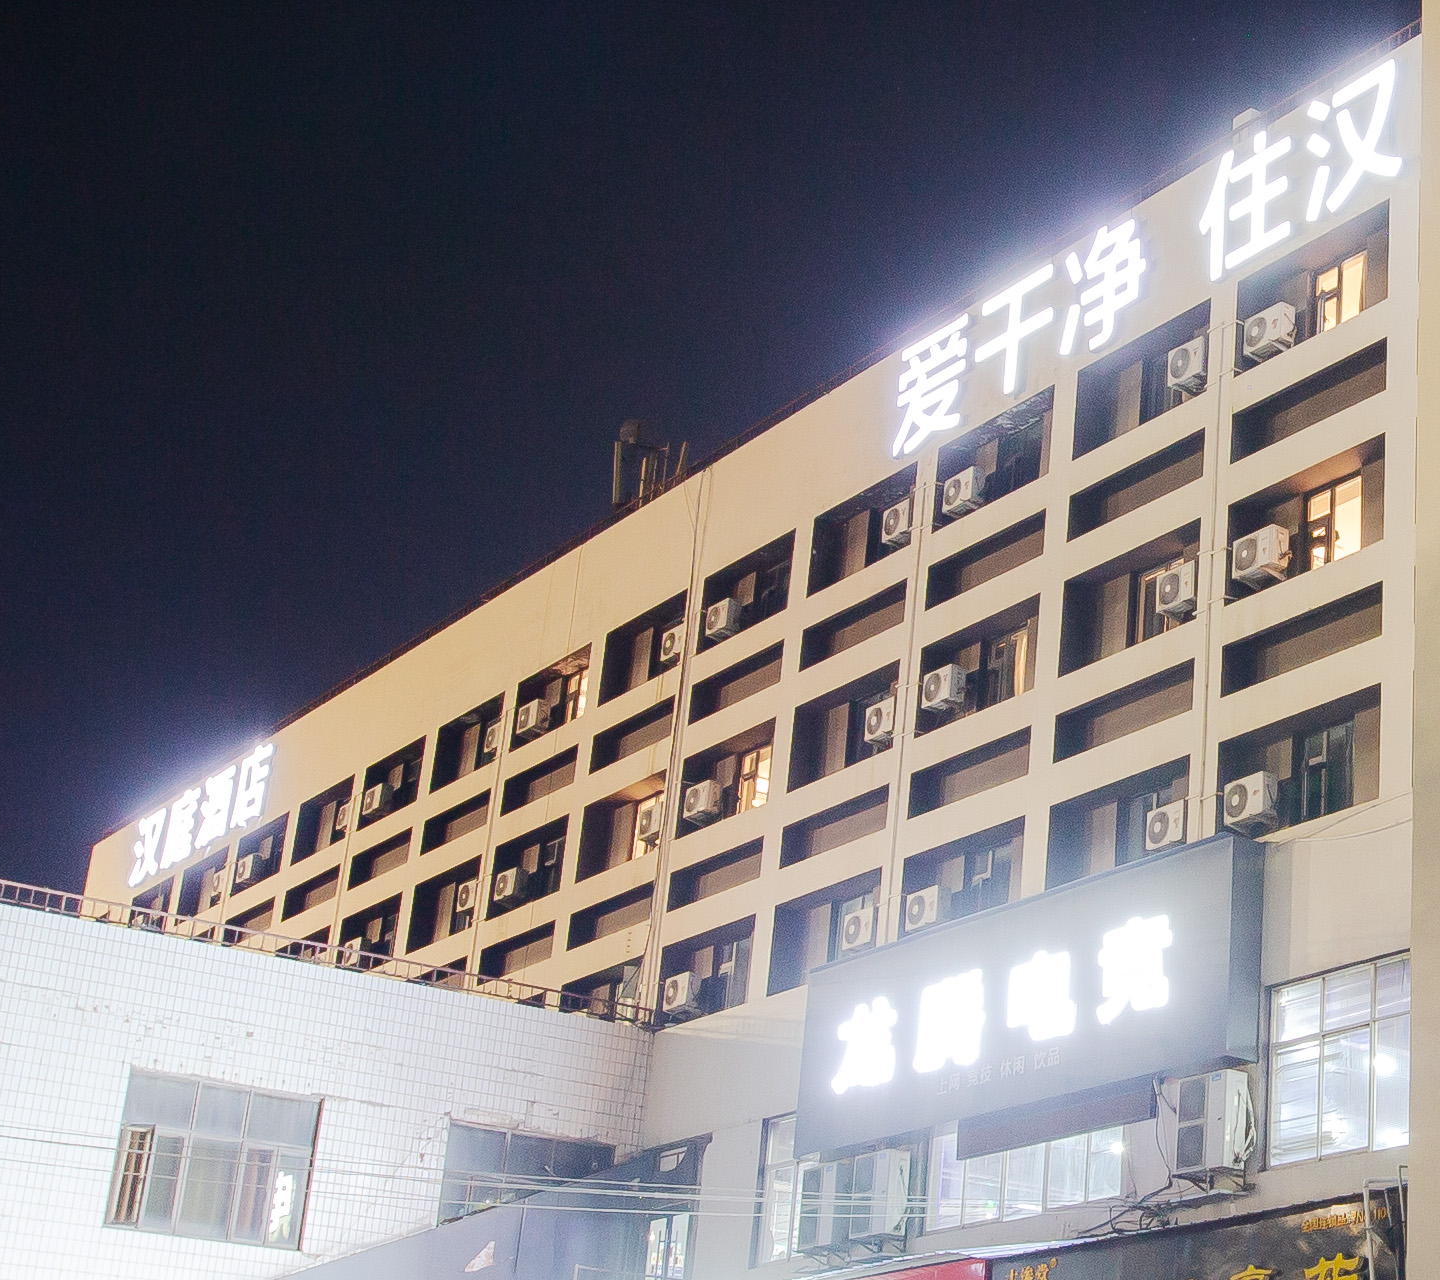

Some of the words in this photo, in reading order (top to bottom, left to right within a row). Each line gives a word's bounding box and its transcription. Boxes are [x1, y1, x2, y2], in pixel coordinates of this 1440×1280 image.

[892, 217, 1147, 458] 爱干净
[1199, 57, 1404, 282] 住汉
[937, 1072, 962, 1096] 上网
[967, 1064, 993, 1088] 竞技
[1000, 1055, 1025, 1079] 休闲
[1033, 1047, 1060, 1070] 饮品
